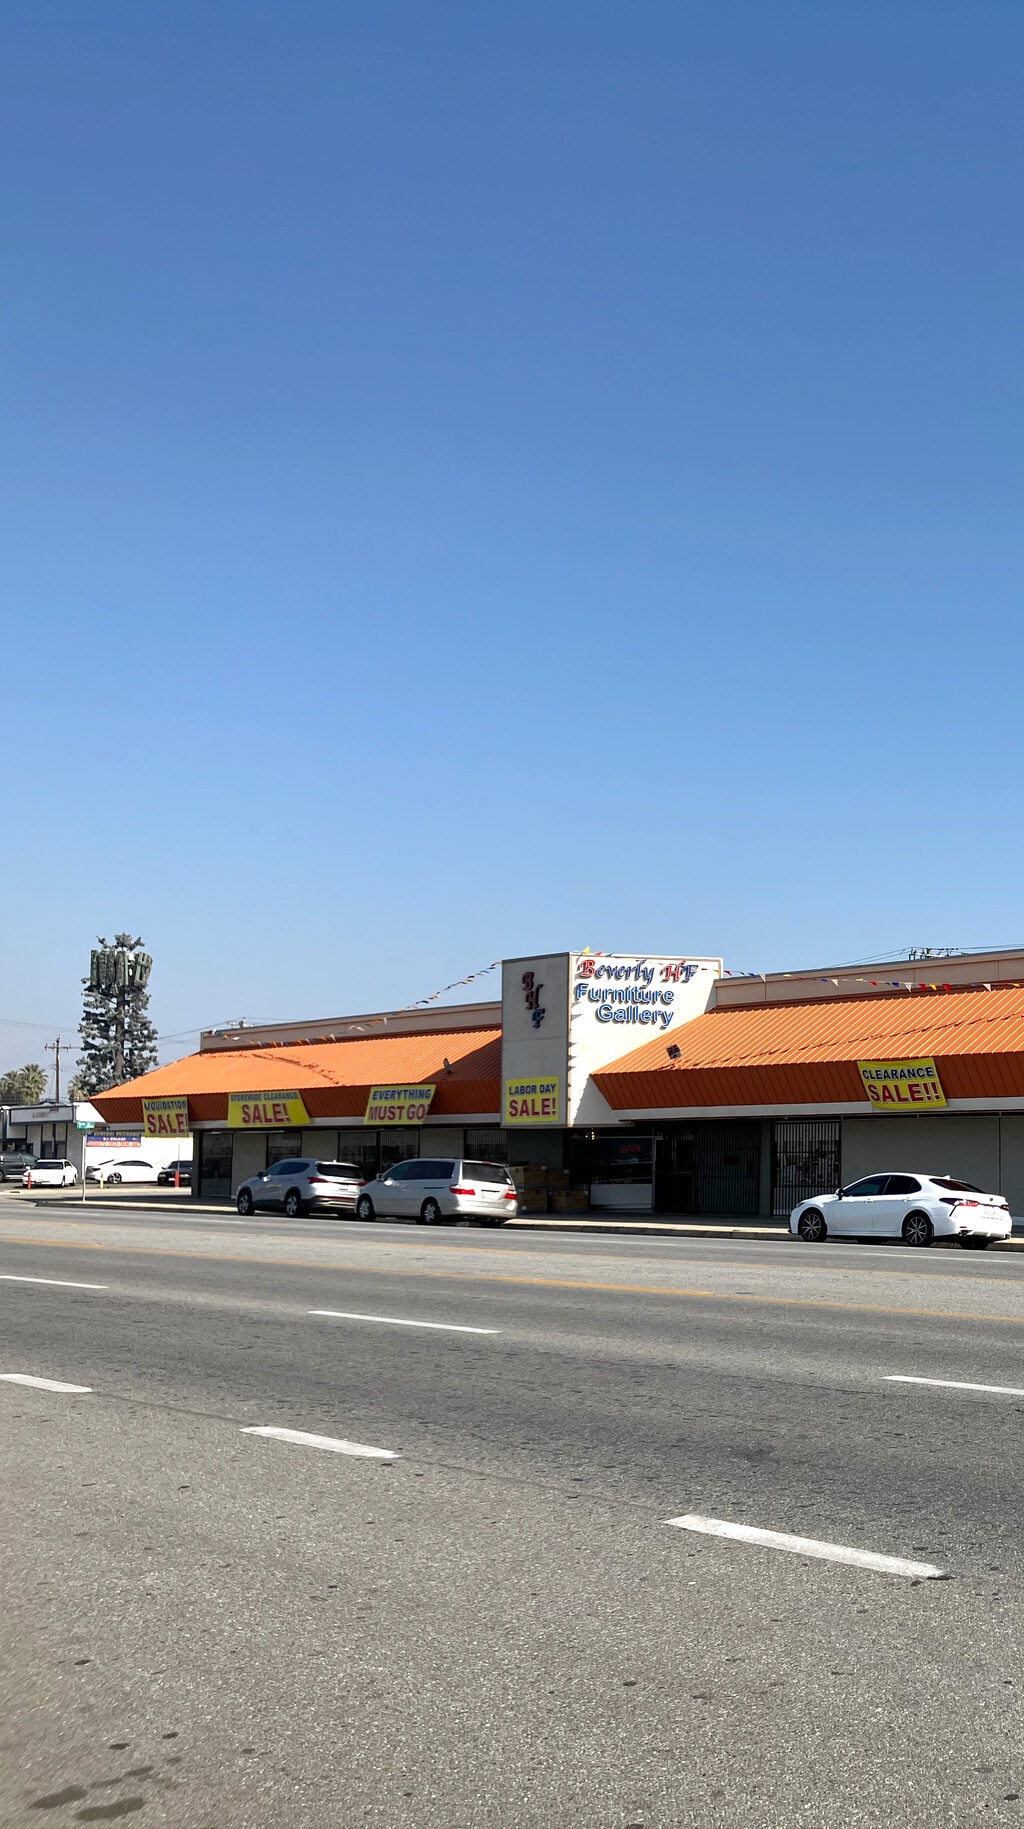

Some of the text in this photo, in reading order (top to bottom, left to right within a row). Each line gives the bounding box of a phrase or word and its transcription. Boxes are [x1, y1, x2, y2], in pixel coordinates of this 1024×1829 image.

[580, 959, 655, 988] Beverly
[576, 983, 675, 1002] Furniture
[598, 1004, 675, 1027] Gallery
[862, 1066, 935, 1080] CLEARANCE
[263, 1091, 299, 1101] CLEARANCE
[372, 1089, 431, 1101] EVERYTHING
[509, 1083, 556, 1095] LABOR DAY
[867, 1081, 941, 1103] SALE!!
[144, 1100, 187, 1110] LIQUIDATION
[241, 1102, 290, 1124] SALE!
[369, 1103, 430, 1121] MUST GO
[509, 1097, 556, 1117] SALE!
